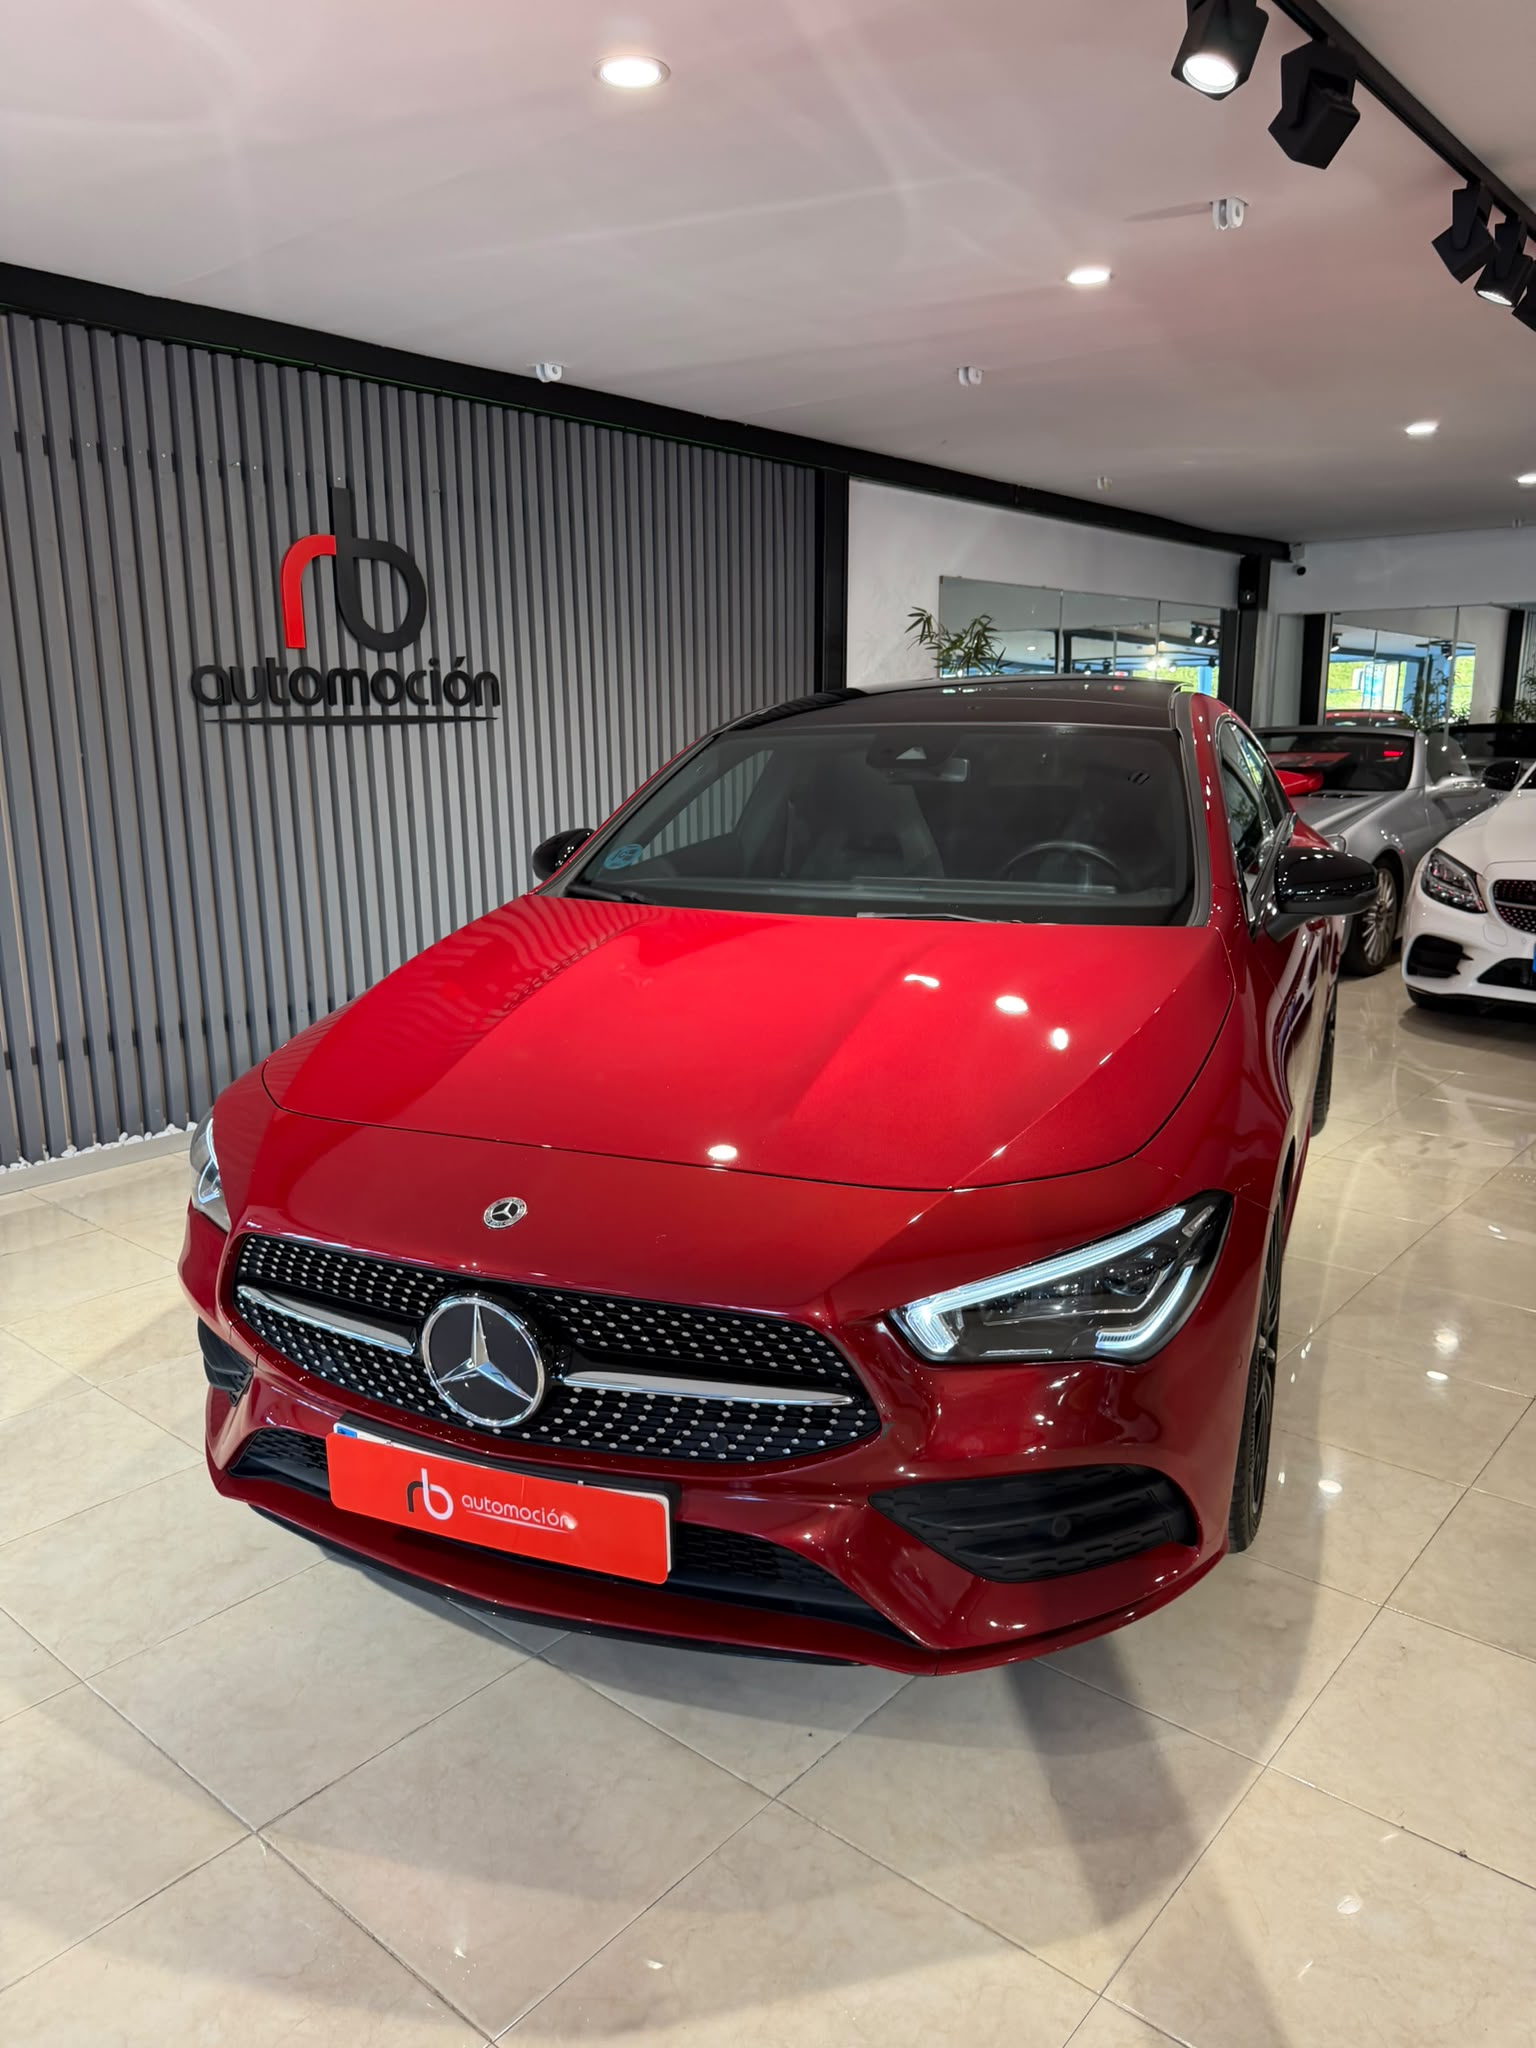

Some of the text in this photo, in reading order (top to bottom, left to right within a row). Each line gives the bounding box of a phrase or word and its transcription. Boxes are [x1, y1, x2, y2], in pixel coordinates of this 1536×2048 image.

[280, 487, 427, 652] rb
[190, 656, 500, 707] automoción
[406, 1468, 574, 1529] rb automoción
